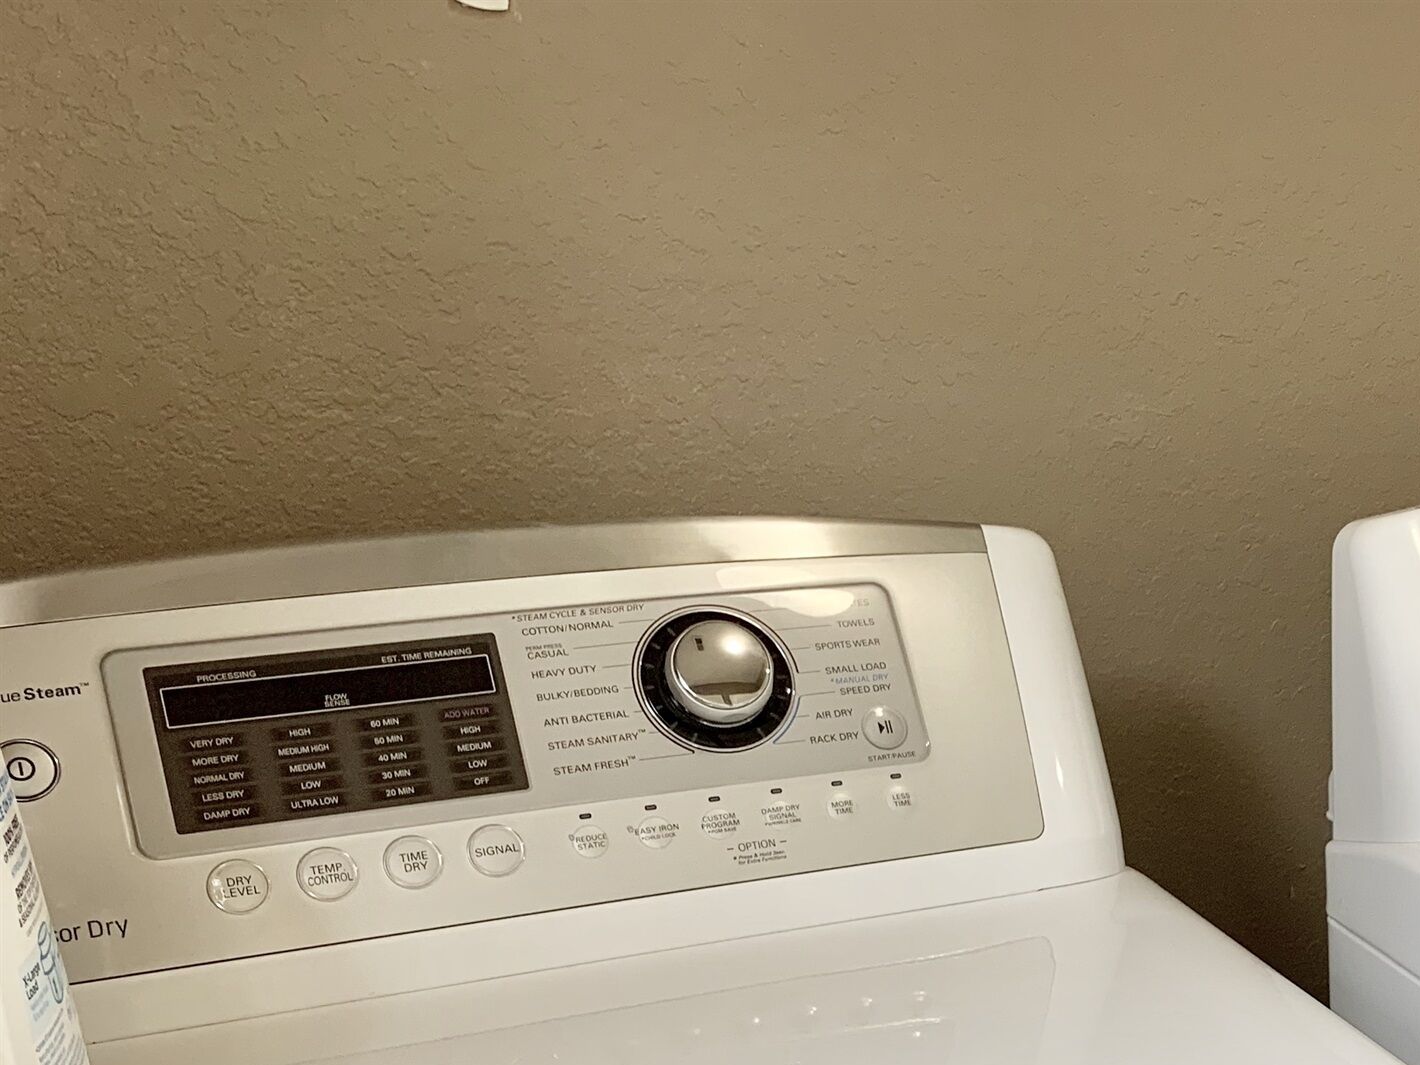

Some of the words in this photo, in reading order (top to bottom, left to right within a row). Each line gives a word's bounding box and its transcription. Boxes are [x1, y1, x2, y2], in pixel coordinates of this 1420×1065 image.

[549, 610, 577, 620] CYCLE
[580, 608, 587, 616] &
[589, 606, 625, 616] SENSOR
[626, 604, 644, 612] DRY
[522, 620, 614, 636] COTTON/NORMAL
[838, 618, 875, 628] TOWELS
[815, 640, 852, 651] SPORTS
[853, 638, 881, 647] WEAR
[381, 654, 400, 664] EST.
[401, 652, 422, 662] TIME
[424, 648, 472, 659] REMAINING
[527, 649, 569, 660] CASUAL
[531, 668, 565, 679] HEAVY
[568, 665, 597, 676] DUTY
[825, 664, 858, 675] SMALL
[861, 662, 887, 671] LOAD
[196, 670, 257, 682] PROCESSING
[836, 676, 869, 685] MANUAL
[536, 686, 619, 702] BULKY/BEDDING
[840, 686, 871, 696] SPEED
[873, 684, 891, 693] DRY
[324, 699, 350, 707] SENSE
[325, 693, 348, 701] FLOW
[444, 710, 461, 719] ADD
[462, 707, 490, 717] WATER
[544, 717, 569, 728] ANTI
[572, 710, 629, 724] BACTERIAL
[816, 711, 832, 720] AIR
[834, 708, 853, 718] DRY
[370, 720, 381, 728] 60
[382, 718, 400, 726] MIN
[289, 728, 311, 737] HIGH
[460, 726, 481, 735] HIGH
[190, 739, 213, 749] VERY
[216, 737, 234, 746] DRY
[386, 734, 404, 744] MIN
[548, 738, 585, 751] STEAM
[810, 734, 837, 745] RACK
[839, 732, 859, 742] DRY
[278, 746, 310, 756] MEDIUM
[310, 744, 330, 753] HIGH
[457, 742, 492, 752] MEDIUM
[192, 757, 219, 767] MORE
[221, 754, 239, 763] DRY
[378, 754, 389, 762] 40
[390, 752, 407, 761] MIN
[289, 762, 326, 773] MEDIUM
[468, 760, 488, 769] LOW
[554, 764, 592, 776] STEAM
[194, 774, 228, 785] NORMAL
[229, 772, 245, 781] DRY
[382, 772, 393, 780] 30
[394, 768, 411, 778] MIN
[301, 780, 321, 790] LOW
[474, 777, 490, 786] OFF
[202, 792, 225, 802] LESS
[226, 790, 245, 800] DRY
[386, 788, 397, 798] 20
[398, 786, 415, 795] MIN
[892, 792, 911, 801] LESS
[290, 799, 319, 809] ULTRA
[320, 796, 339, 806] LOW
[831, 800, 854, 808] MORE
[894, 800, 912, 808] TIME
[204, 810, 231, 821] DAMP
[232, 808, 250, 817] DRY
[761, 806, 784, 815] DAMP
[786, 804, 800, 812] DRY
[835, 807, 854, 816] TIME
[702, 812, 737, 823] CUSTOM
[769, 812, 797, 821] SIGNAL
[634, 826, 657, 836] EASY
[658, 824, 680, 832] IRON
[701, 820, 741, 830] PROGRAM
[576, 832, 608, 843] REDUCE
[475, 843, 520, 858] SIGNAL
[577, 841, 606, 851] STATIC
[738, 840, 777, 852] OPTION
[399, 850, 429, 863] TIME
[404, 861, 429, 873] DRY
[226, 875, 252, 888] DRY
[308, 872, 354, 887] CONTROL
[224, 886, 261, 899] LEVEL
[54, 926, 81, 943] or
[88, 919, 128, 939] Dry
